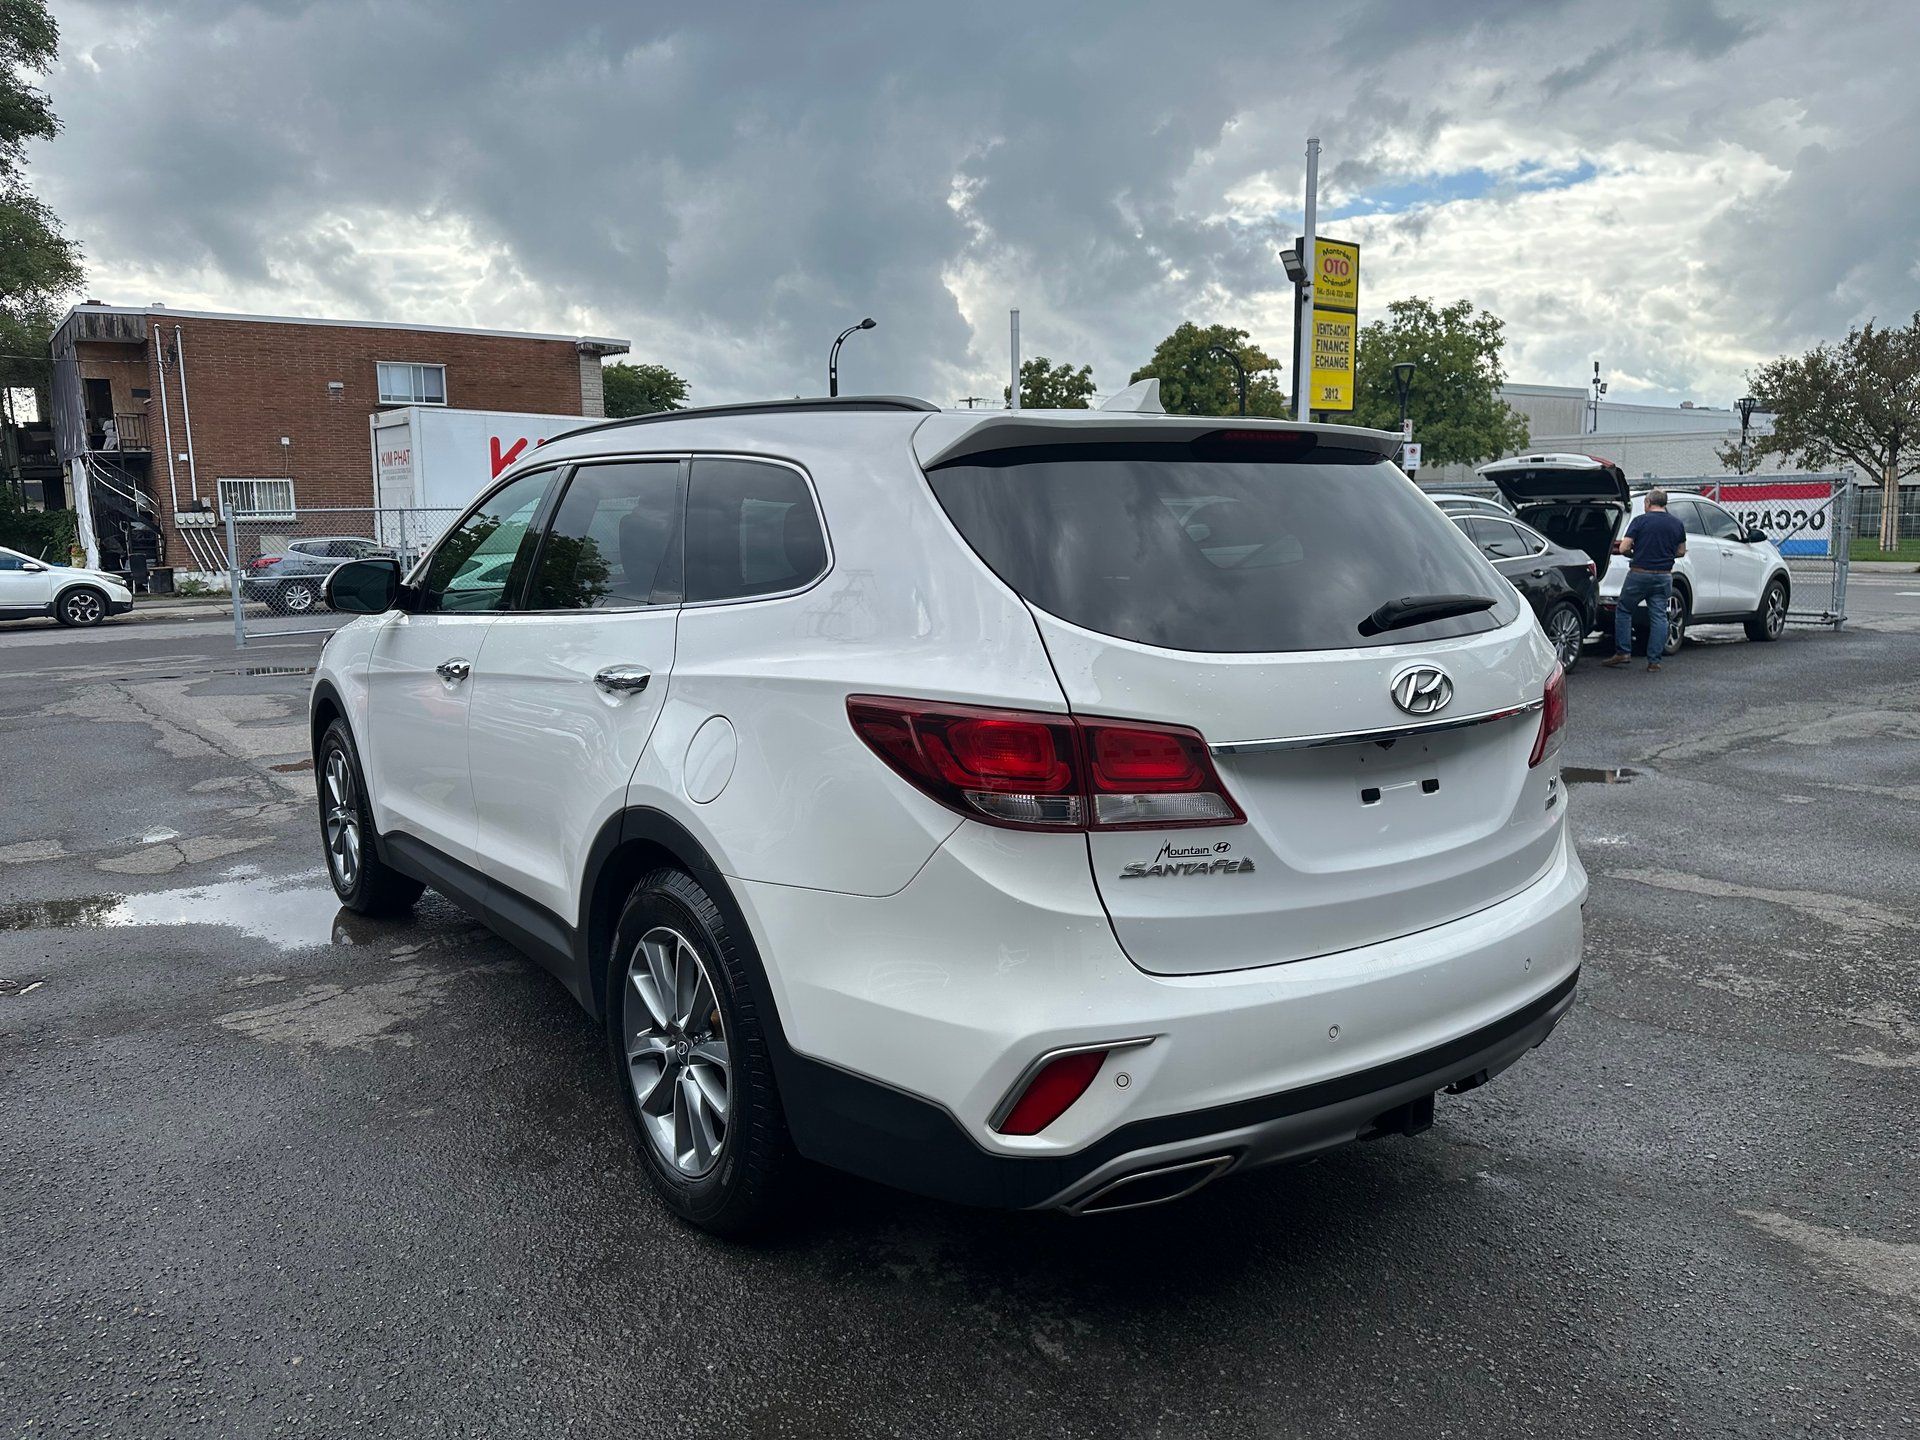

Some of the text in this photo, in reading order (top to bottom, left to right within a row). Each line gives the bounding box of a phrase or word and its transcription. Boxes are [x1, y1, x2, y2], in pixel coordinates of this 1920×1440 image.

[1324, 258, 1349, 276] OTO
[1316, 322, 1350, 337] VENTE-ACHAT
[1316, 338, 1349, 353] FINANCE
[1315, 354, 1349, 369] ECHANGE
[1324, 387, 1339, 400] 3812
[381, 449, 410, 467] KIM PHAT
[1154, 838, 1212, 862] Mountain
